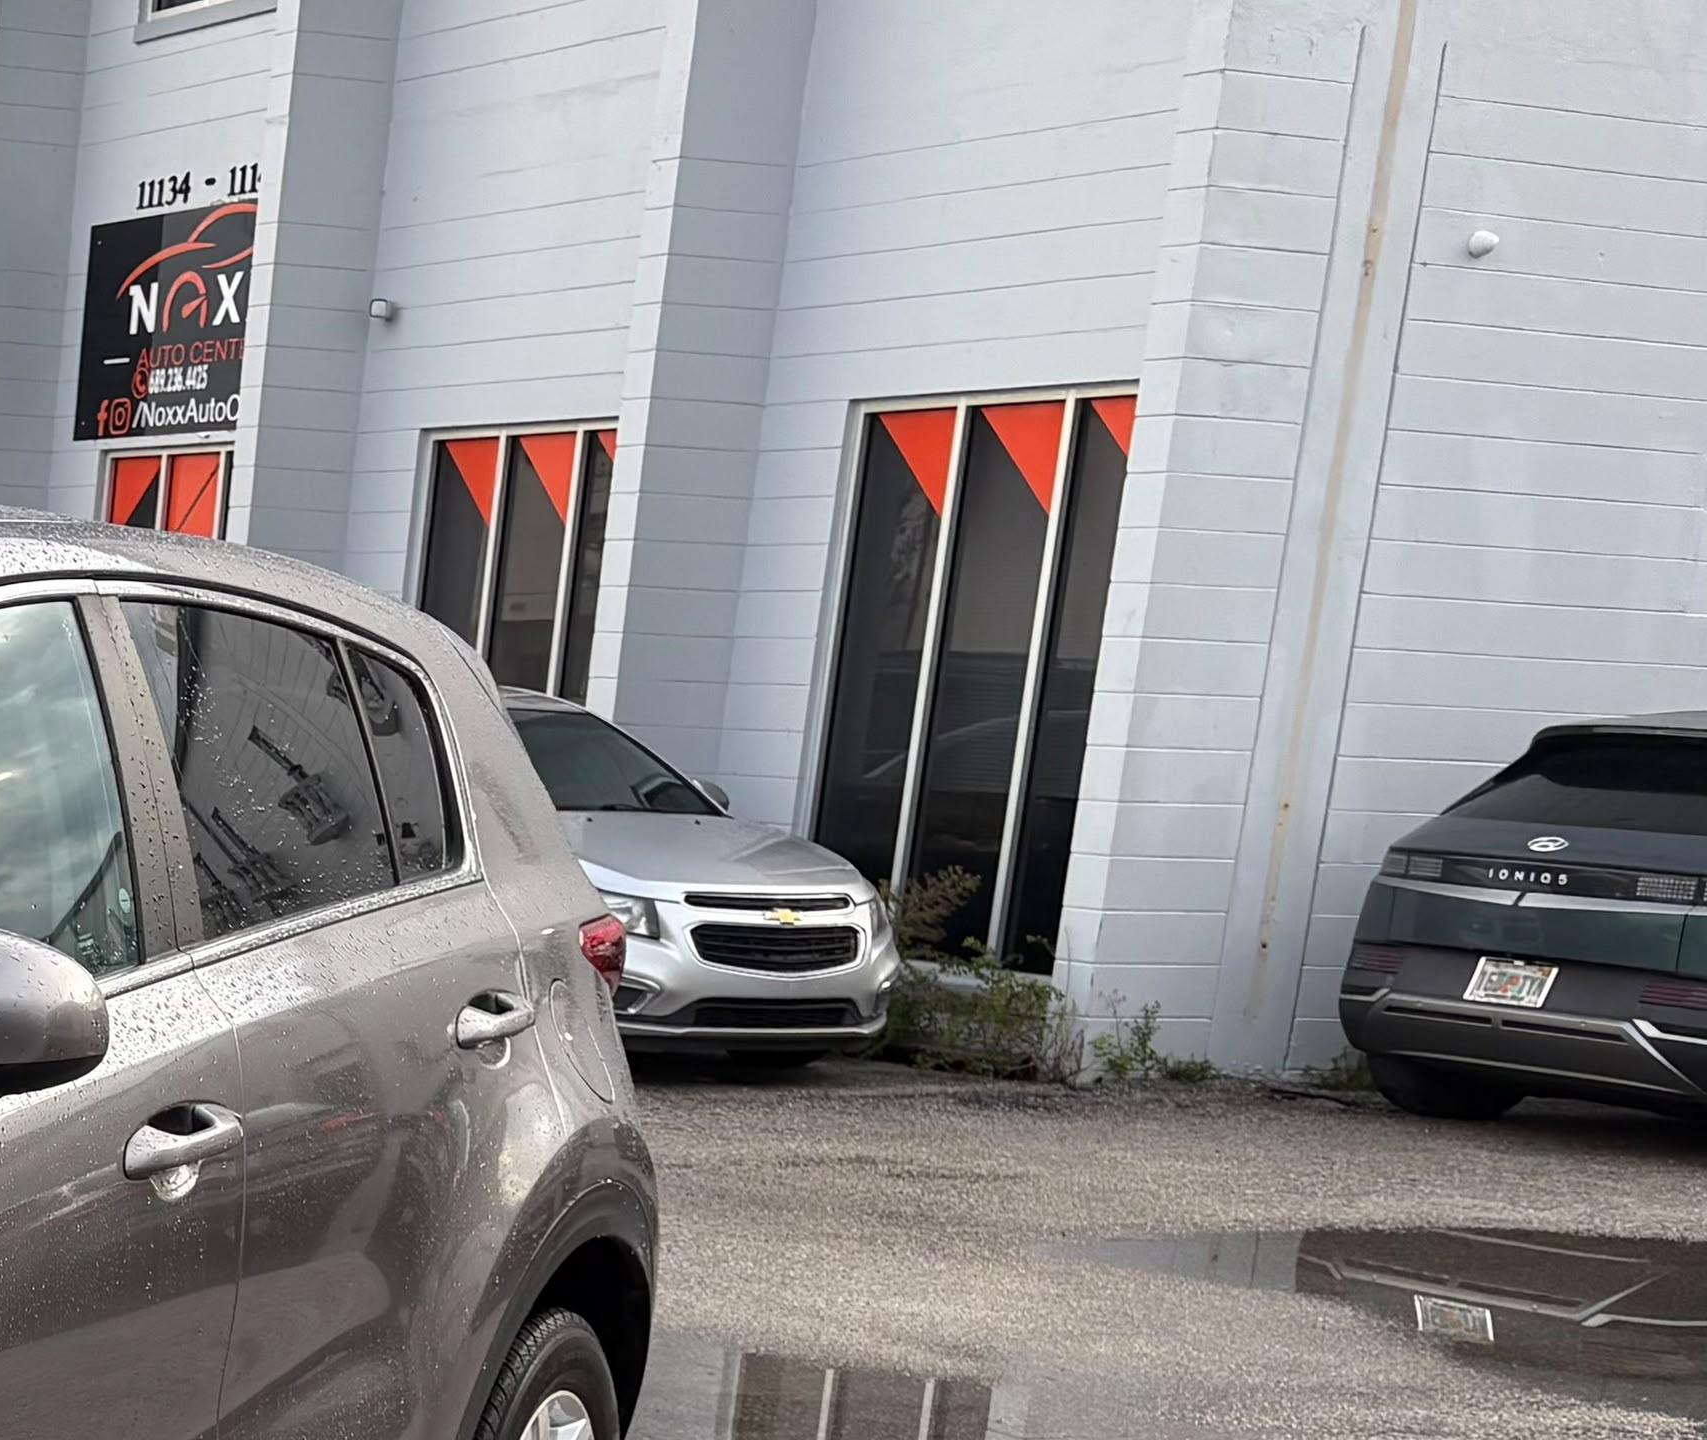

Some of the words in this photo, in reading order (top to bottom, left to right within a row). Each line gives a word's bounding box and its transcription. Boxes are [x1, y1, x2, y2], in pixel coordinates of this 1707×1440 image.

[136, 171, 191, 210] 11134
[227, 162, 262, 197] 111
[137, 344, 185, 369] AUTO
